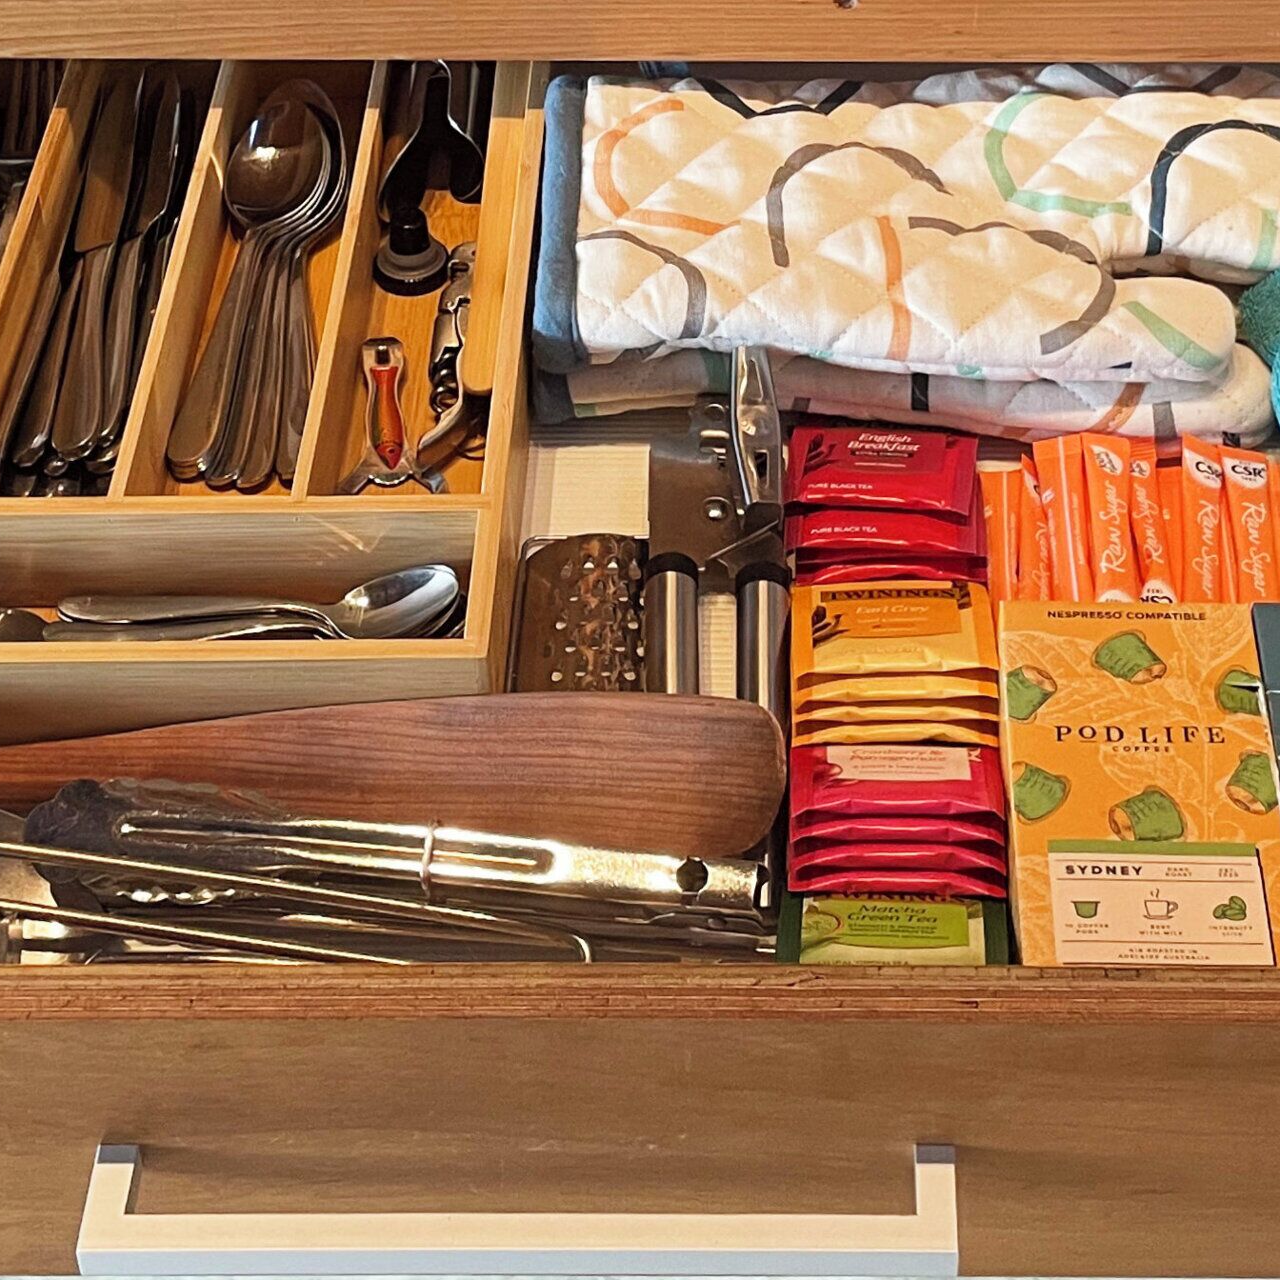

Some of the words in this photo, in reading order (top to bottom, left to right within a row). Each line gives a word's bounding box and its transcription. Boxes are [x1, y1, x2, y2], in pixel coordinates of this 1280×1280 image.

[858, 433, 912, 443] English
[848, 441, 920, 451] Breakfast
[1231, 464, 1264, 479] CSR
[1099, 480, 1128, 524] Sugar
[1132, 483, 1159, 525] Sugar
[811, 526, 832, 534] PURE
[1197, 500, 1220, 549] Raw
[1241, 501, 1267, 545] Raw
[1100, 526, 1126, 573] Raw
[1143, 523, 1164, 564] Raw
[1192, 546, 1219, 600] Sugar
[1241, 546, 1271, 597] Sugar
[829, 589, 956, 600] TWININGS
[856, 605, 888, 614] Earl
[890, 604, 929, 614] Grey
[1047, 610, 1122, 619] NESPRESSO
[1126, 611, 1206, 620] COMPATIBLE
[1055, 725, 1124, 742] POD
[1139, 726, 1225, 744] LIFE
[1065, 865, 1143, 876] SYDNEY
[859, 904, 926, 913] Matcha
[848, 913, 899, 922] Green
[906, 914, 938, 923] Tea
